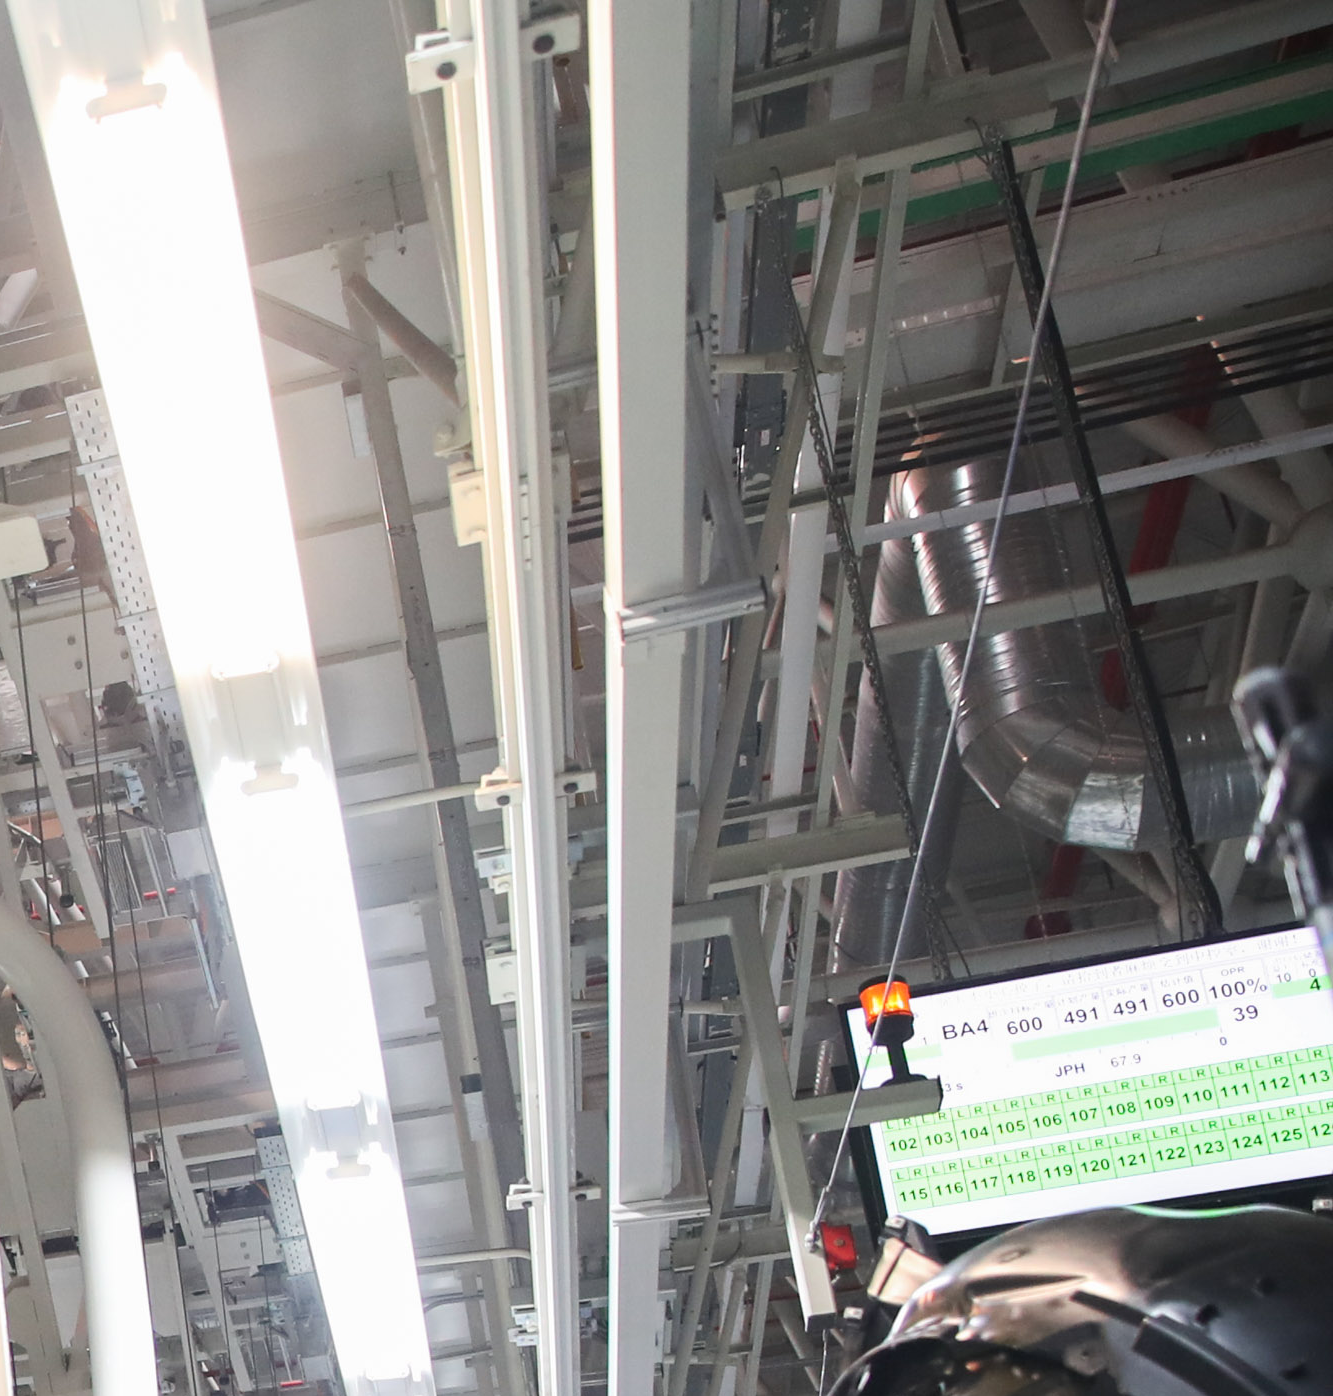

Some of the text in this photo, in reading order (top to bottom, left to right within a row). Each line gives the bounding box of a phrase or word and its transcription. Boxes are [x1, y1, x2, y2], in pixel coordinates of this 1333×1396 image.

[1221, 966, 1245, 977] OPR
[1310, 978, 1321, 991] 4
[942, 1019, 989, 1040] BA4
[1007, 1016, 1042, 1035] 600
[1064, 1006, 1098, 1024] 491
[1113, 998, 1148, 1016] 491
[1162, 989, 1200, 1007] 600
[1209, 978, 1268, 999] 100%
[1233, 1004, 1259, 1021] 39
[1055, 1053, 1141, 1077] JPH 67.9
[889, 1070, 1330, 1152] 102 103 104 105 106 107 108 109 110 111 112 113
[900, 1123, 1333, 1202] 115 116 117 118 119 120 121 122 123 124 125 12
